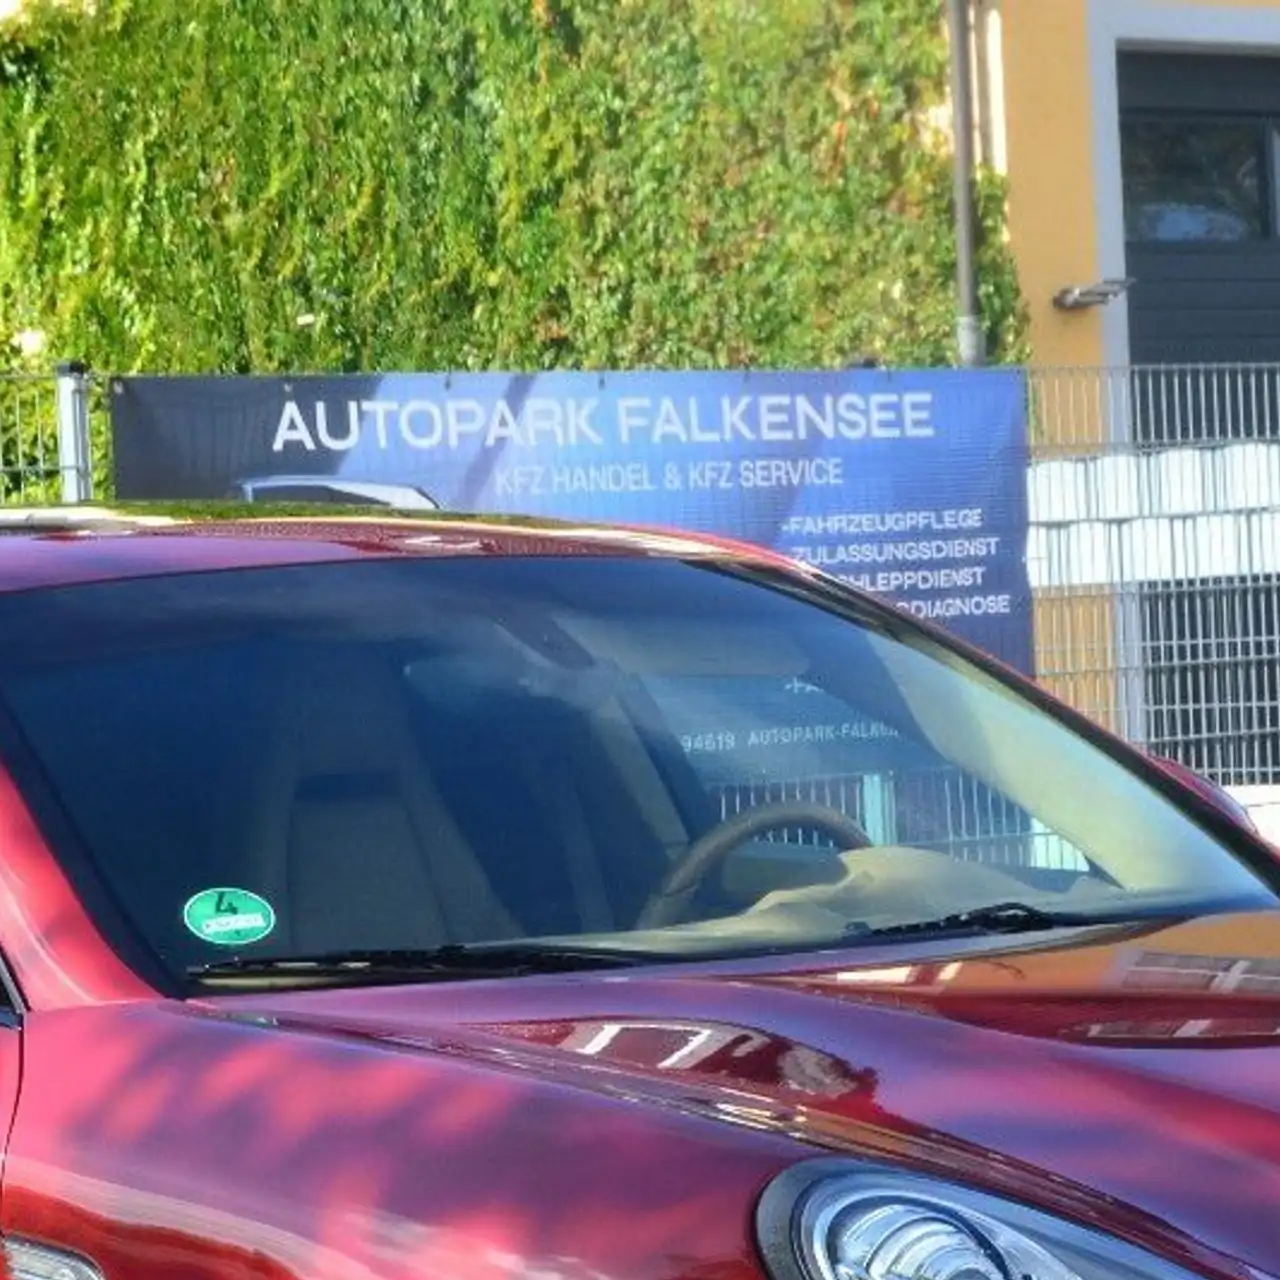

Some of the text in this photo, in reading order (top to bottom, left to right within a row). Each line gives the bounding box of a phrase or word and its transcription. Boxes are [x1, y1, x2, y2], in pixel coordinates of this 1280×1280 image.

[273, 393, 934, 451] AUTOPARK FALKENSEE
[495, 456, 844, 495] KFZ HANDEL & KFZ SERVICE
